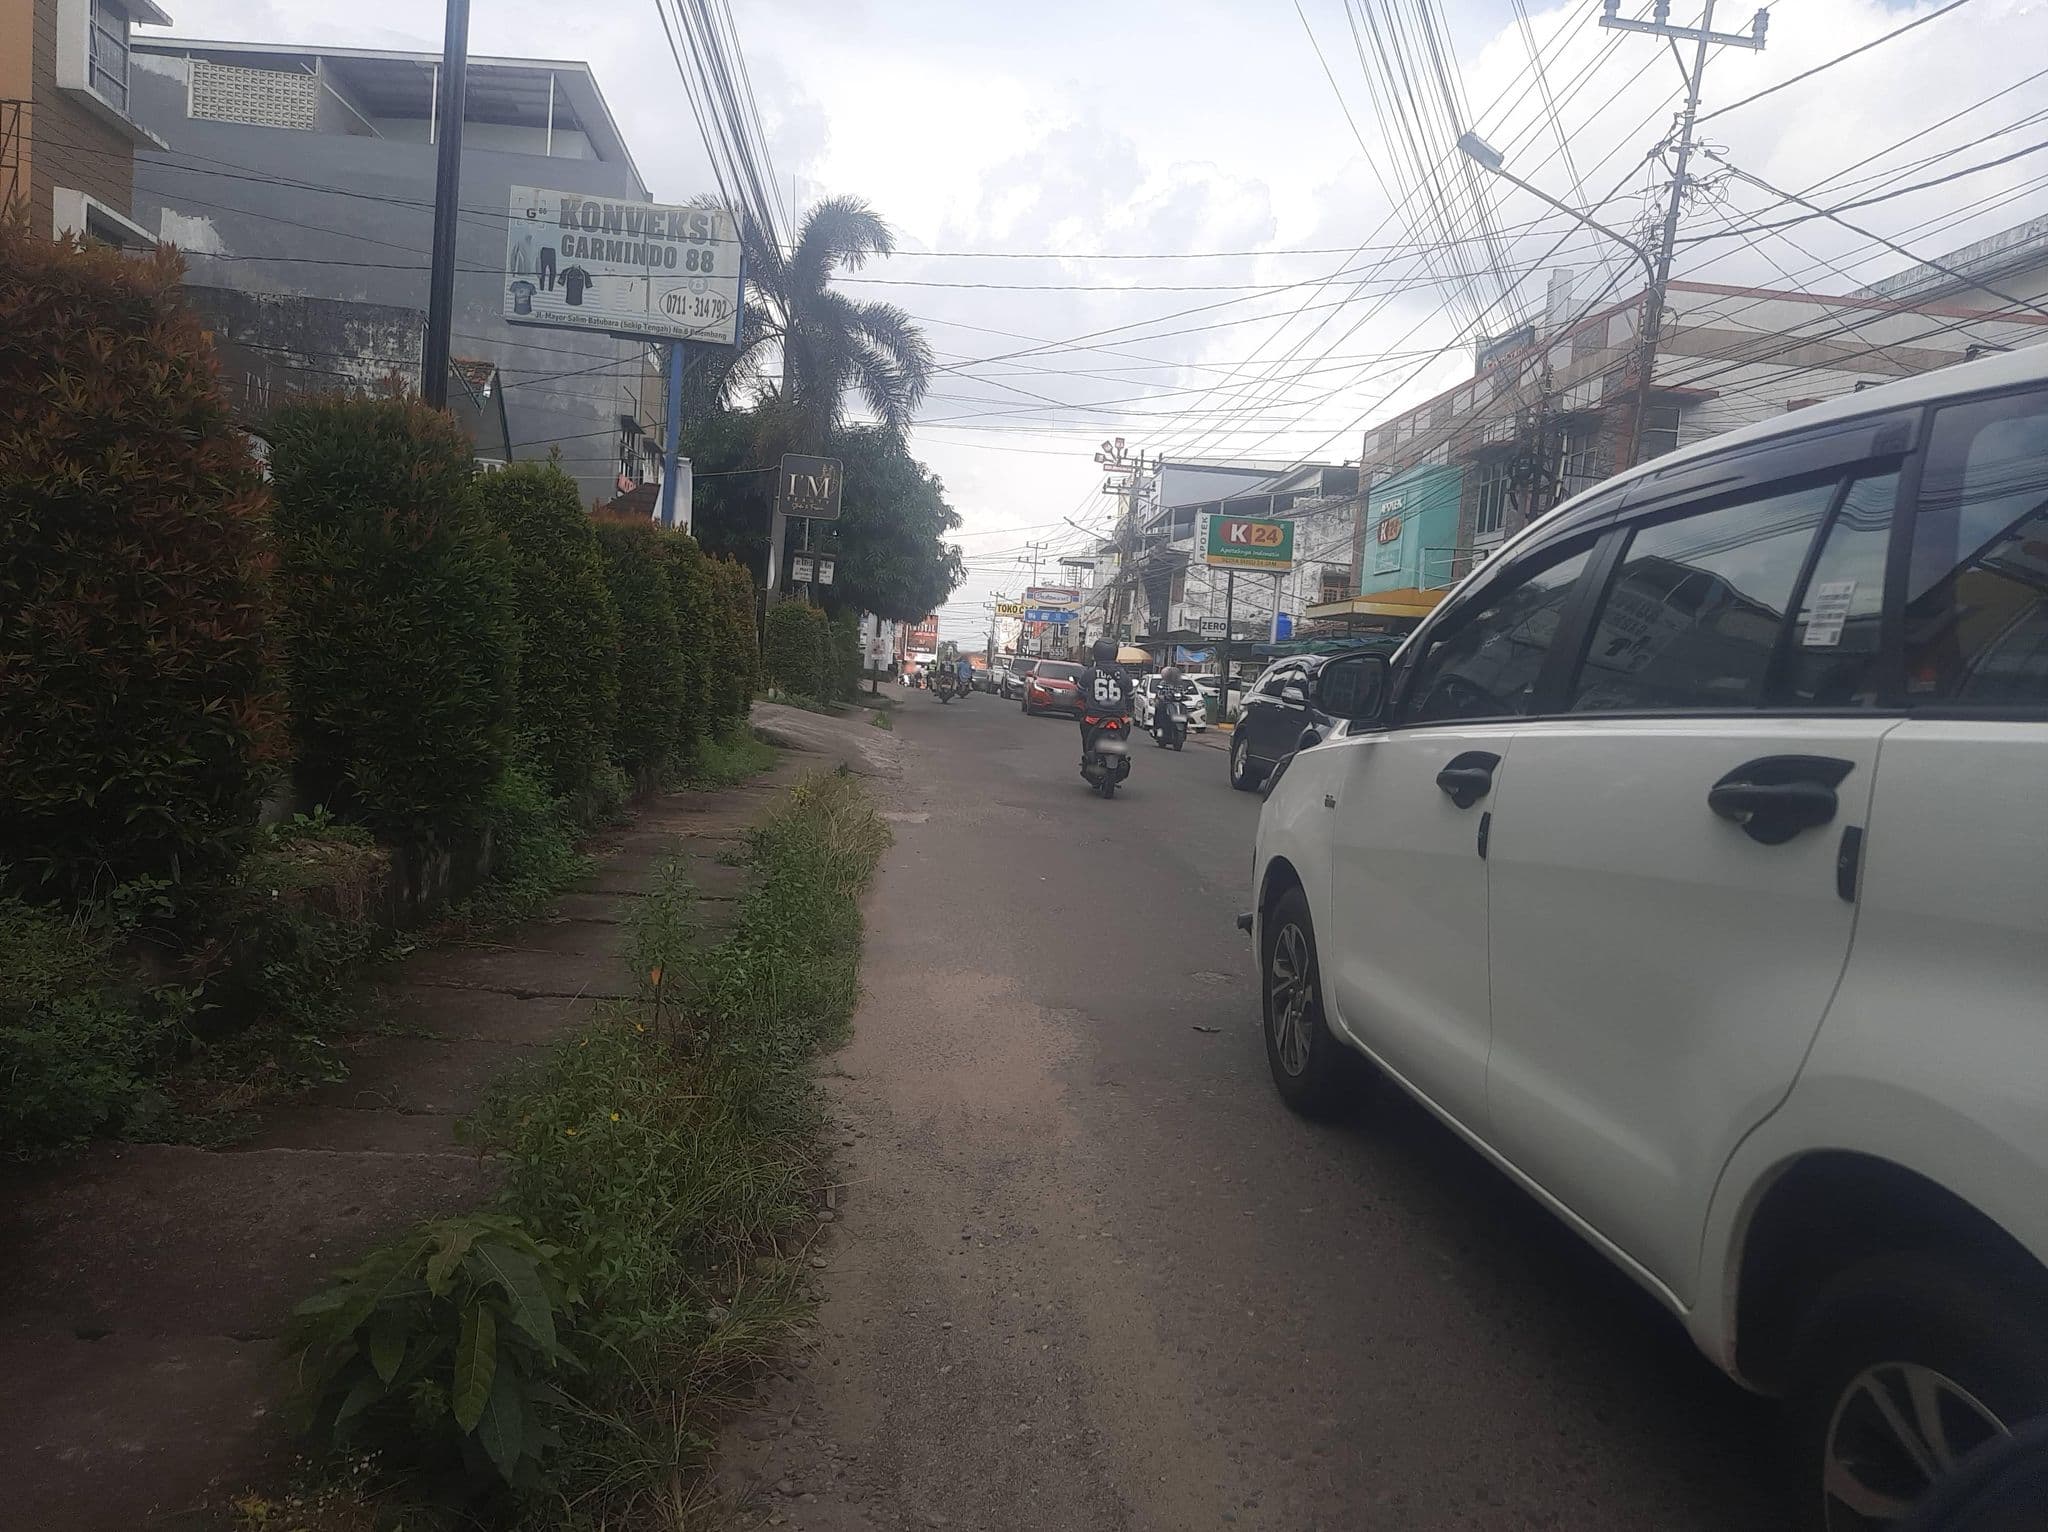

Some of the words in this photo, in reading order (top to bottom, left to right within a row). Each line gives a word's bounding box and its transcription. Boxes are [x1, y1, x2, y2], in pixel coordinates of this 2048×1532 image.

[526, 207, 537, 218] G
[559, 198, 721, 247] KONVEKSI
[561, 233, 678, 269] GARMINDO
[686, 248, 715, 274] 88
[666, 294, 687, 315] 0711
[588, 315, 619, 327] Batubara
[788, 473, 831, 499] I'M
[1199, 515, 1209, 560] APOTEK
[997, 604, 1018, 614] TOKO
[1201, 621, 1226, 631] ZERO
[1094, 678, 1121, 701] 66
